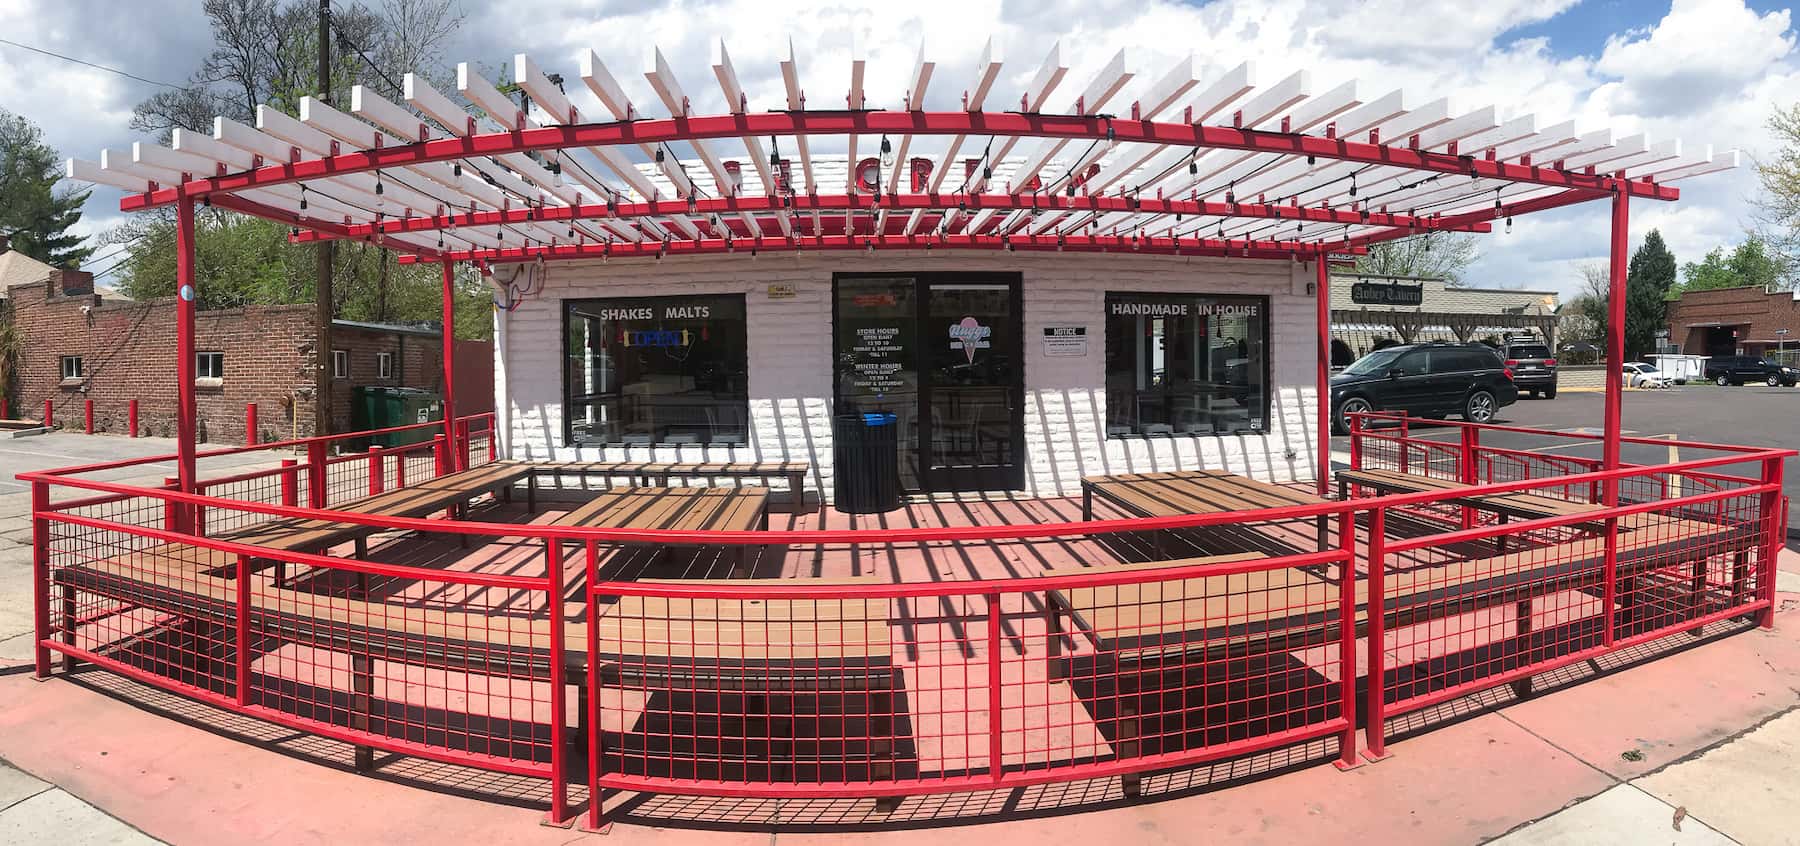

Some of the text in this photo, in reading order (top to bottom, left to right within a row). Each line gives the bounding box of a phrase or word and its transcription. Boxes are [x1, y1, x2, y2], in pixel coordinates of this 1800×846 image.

[600, 306, 710, 320] SHAKES MALTS
[1112, 303, 1257, 316] HANDMADE IN HOUSE
[634, 330, 680, 346] OPEN
[1053, 328, 1077, 336] NOTICE
